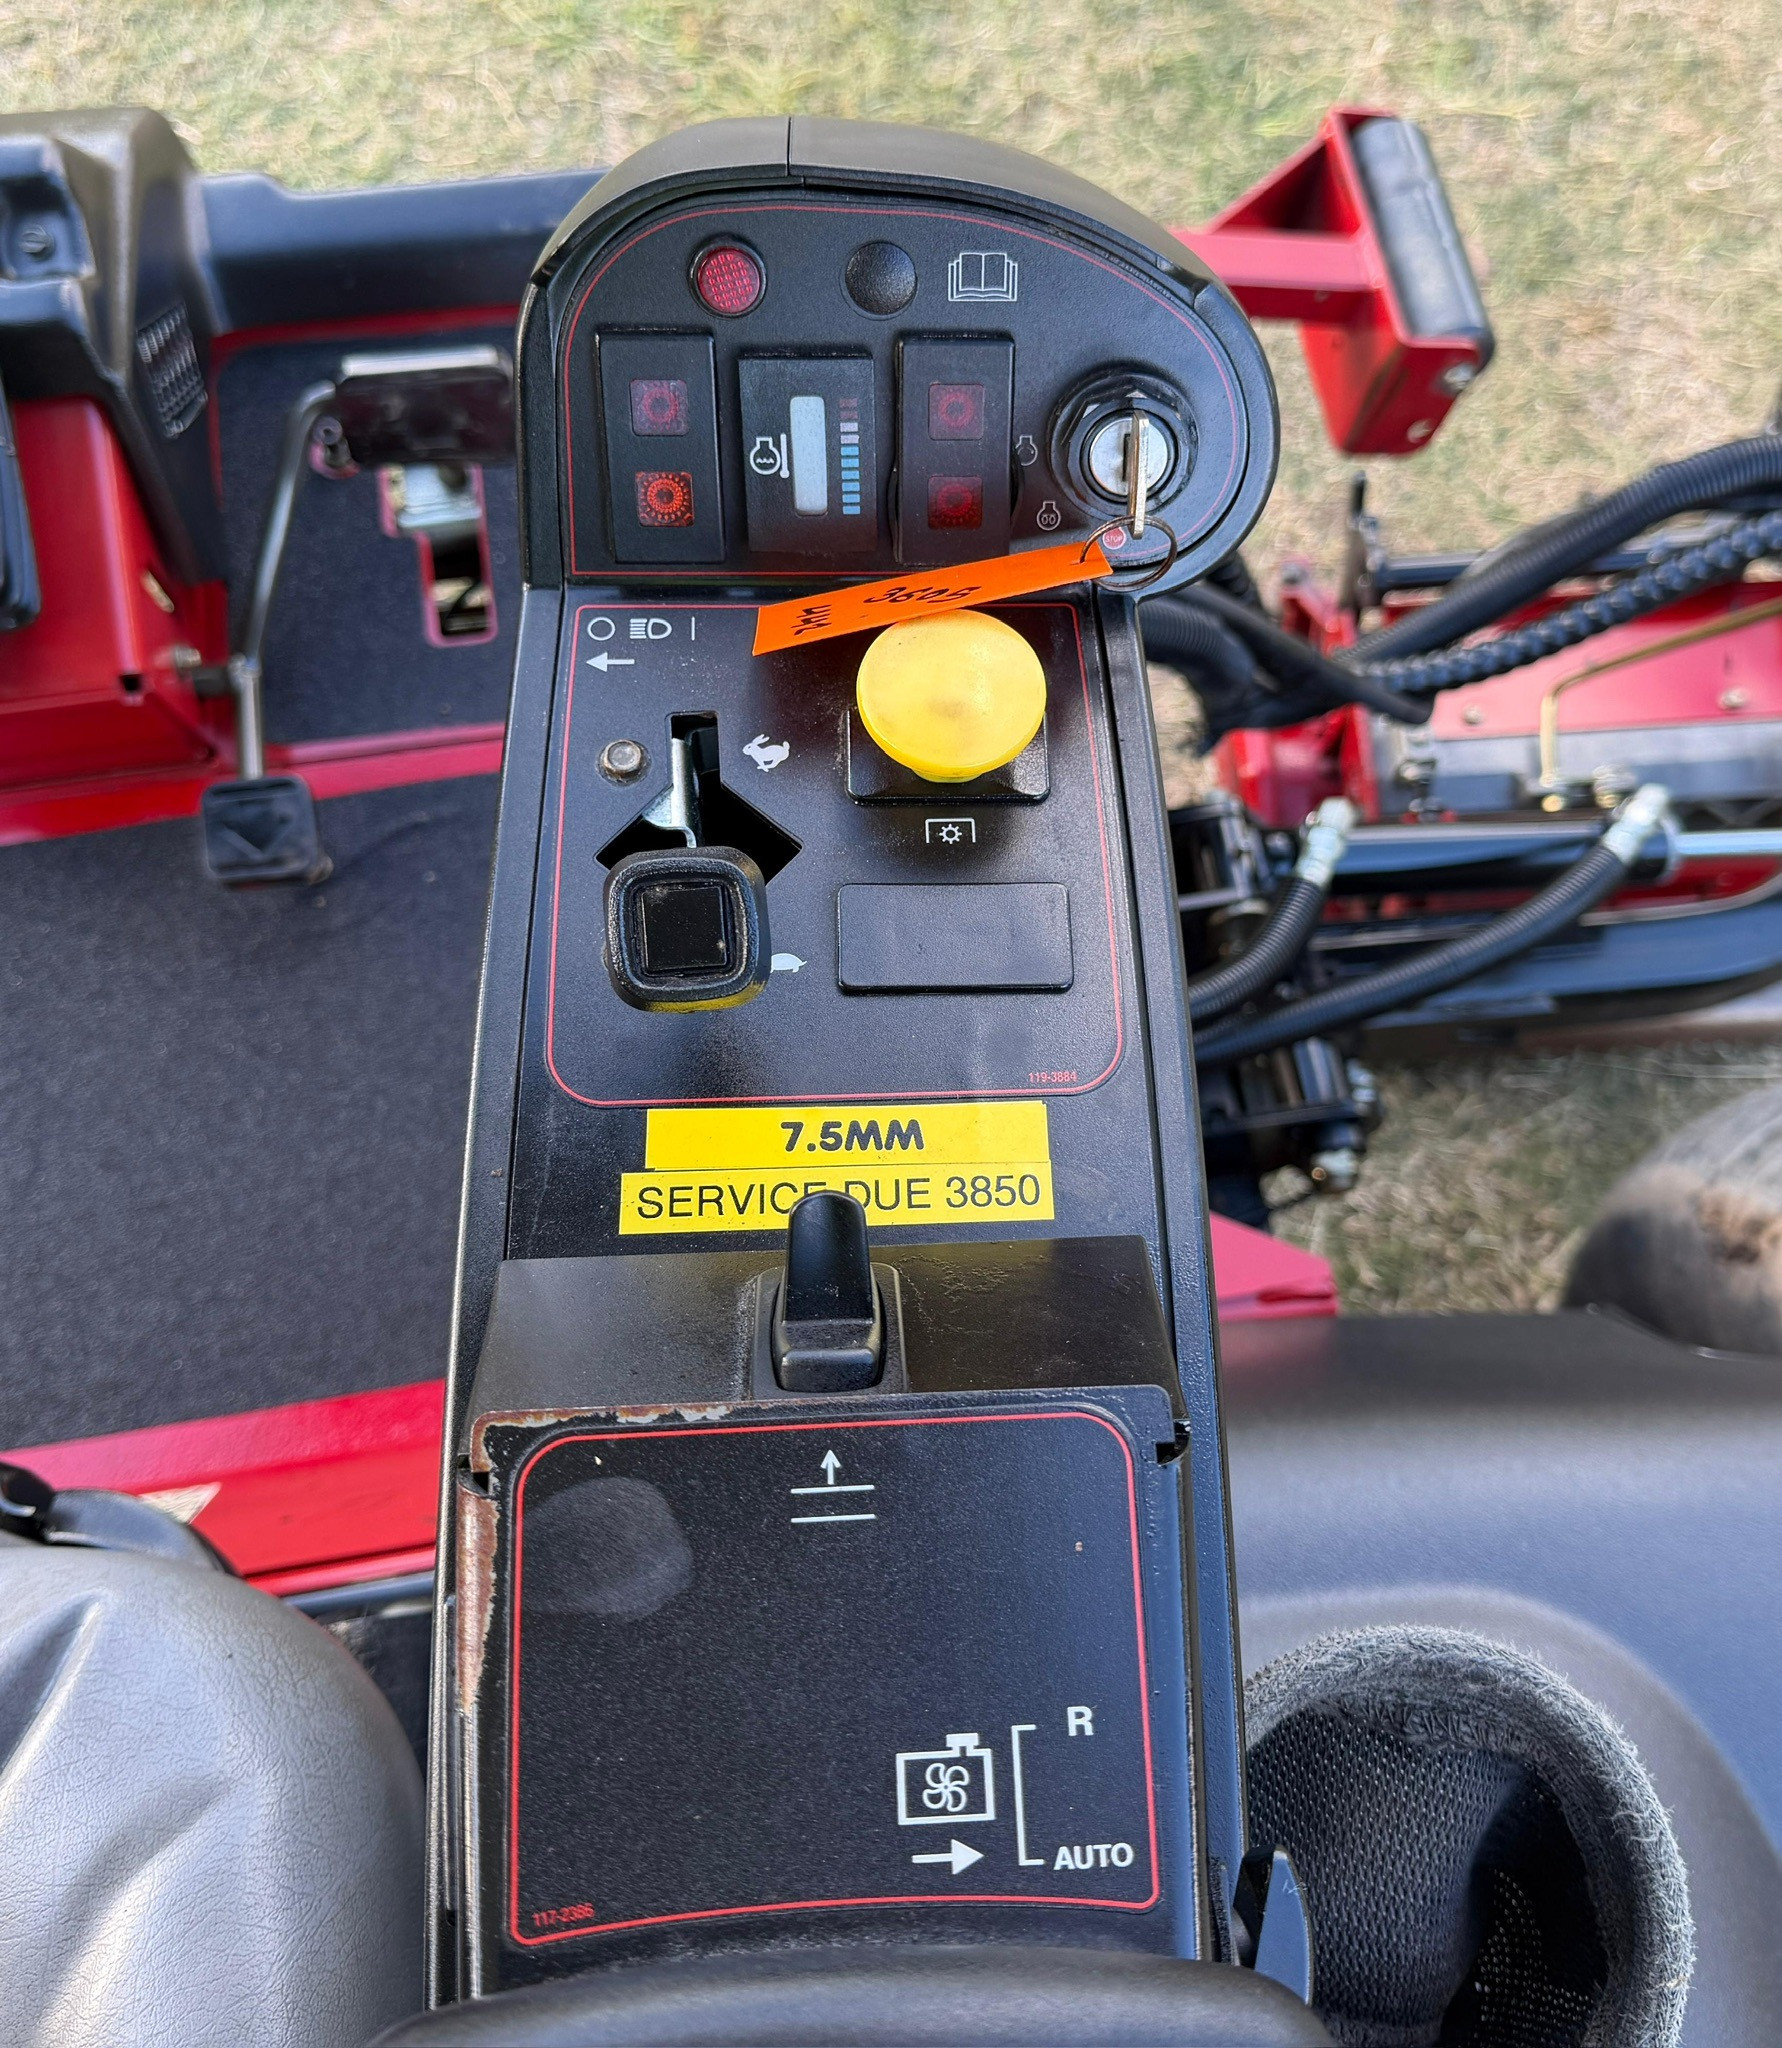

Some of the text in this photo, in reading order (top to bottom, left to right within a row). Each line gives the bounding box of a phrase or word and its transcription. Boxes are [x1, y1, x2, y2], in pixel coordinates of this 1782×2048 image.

[1105, 534, 1123, 543] STOP
[1028, 1070, 1078, 1083] 119-3884
[780, 1119, 925, 1153] 7.5MM
[637, 1181, 828, 1219] SERVIC
[945, 1173, 1041, 1209] 3850
[1067, 1706, 1094, 1736] R
[1053, 1842, 1134, 1871] AUTO
